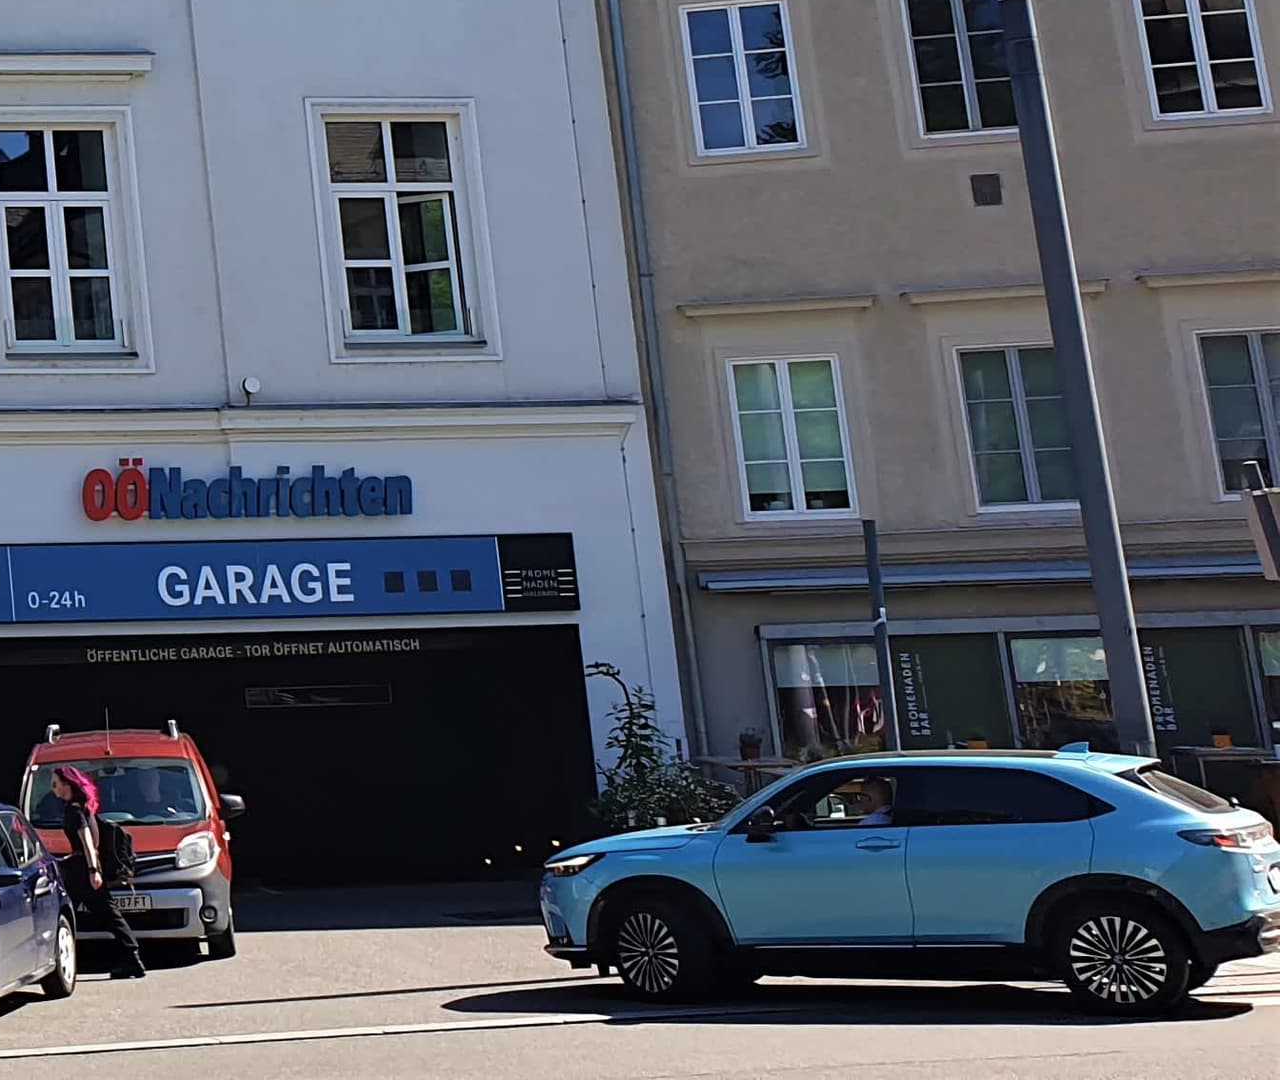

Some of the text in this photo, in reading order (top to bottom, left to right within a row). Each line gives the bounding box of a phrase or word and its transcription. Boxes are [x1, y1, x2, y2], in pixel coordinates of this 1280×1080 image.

[81, 457, 414, 522] OÖNachrichten
[27, 590, 87, 609] 0-24h
[156, 562, 355, 607] GARAGE
[86, 648, 178, 664] ÖFFENTLICHE
[180, 645, 234, 660] GARAGE
[244, 643, 271, 658] TOR
[273, 641, 325, 657] ÖFFNET
[327, 638, 421, 654] AUTOMATISCH
[898, 652, 921, 736] PROMENADEN
[1142, 646, 1166, 731] PROMENADEN
